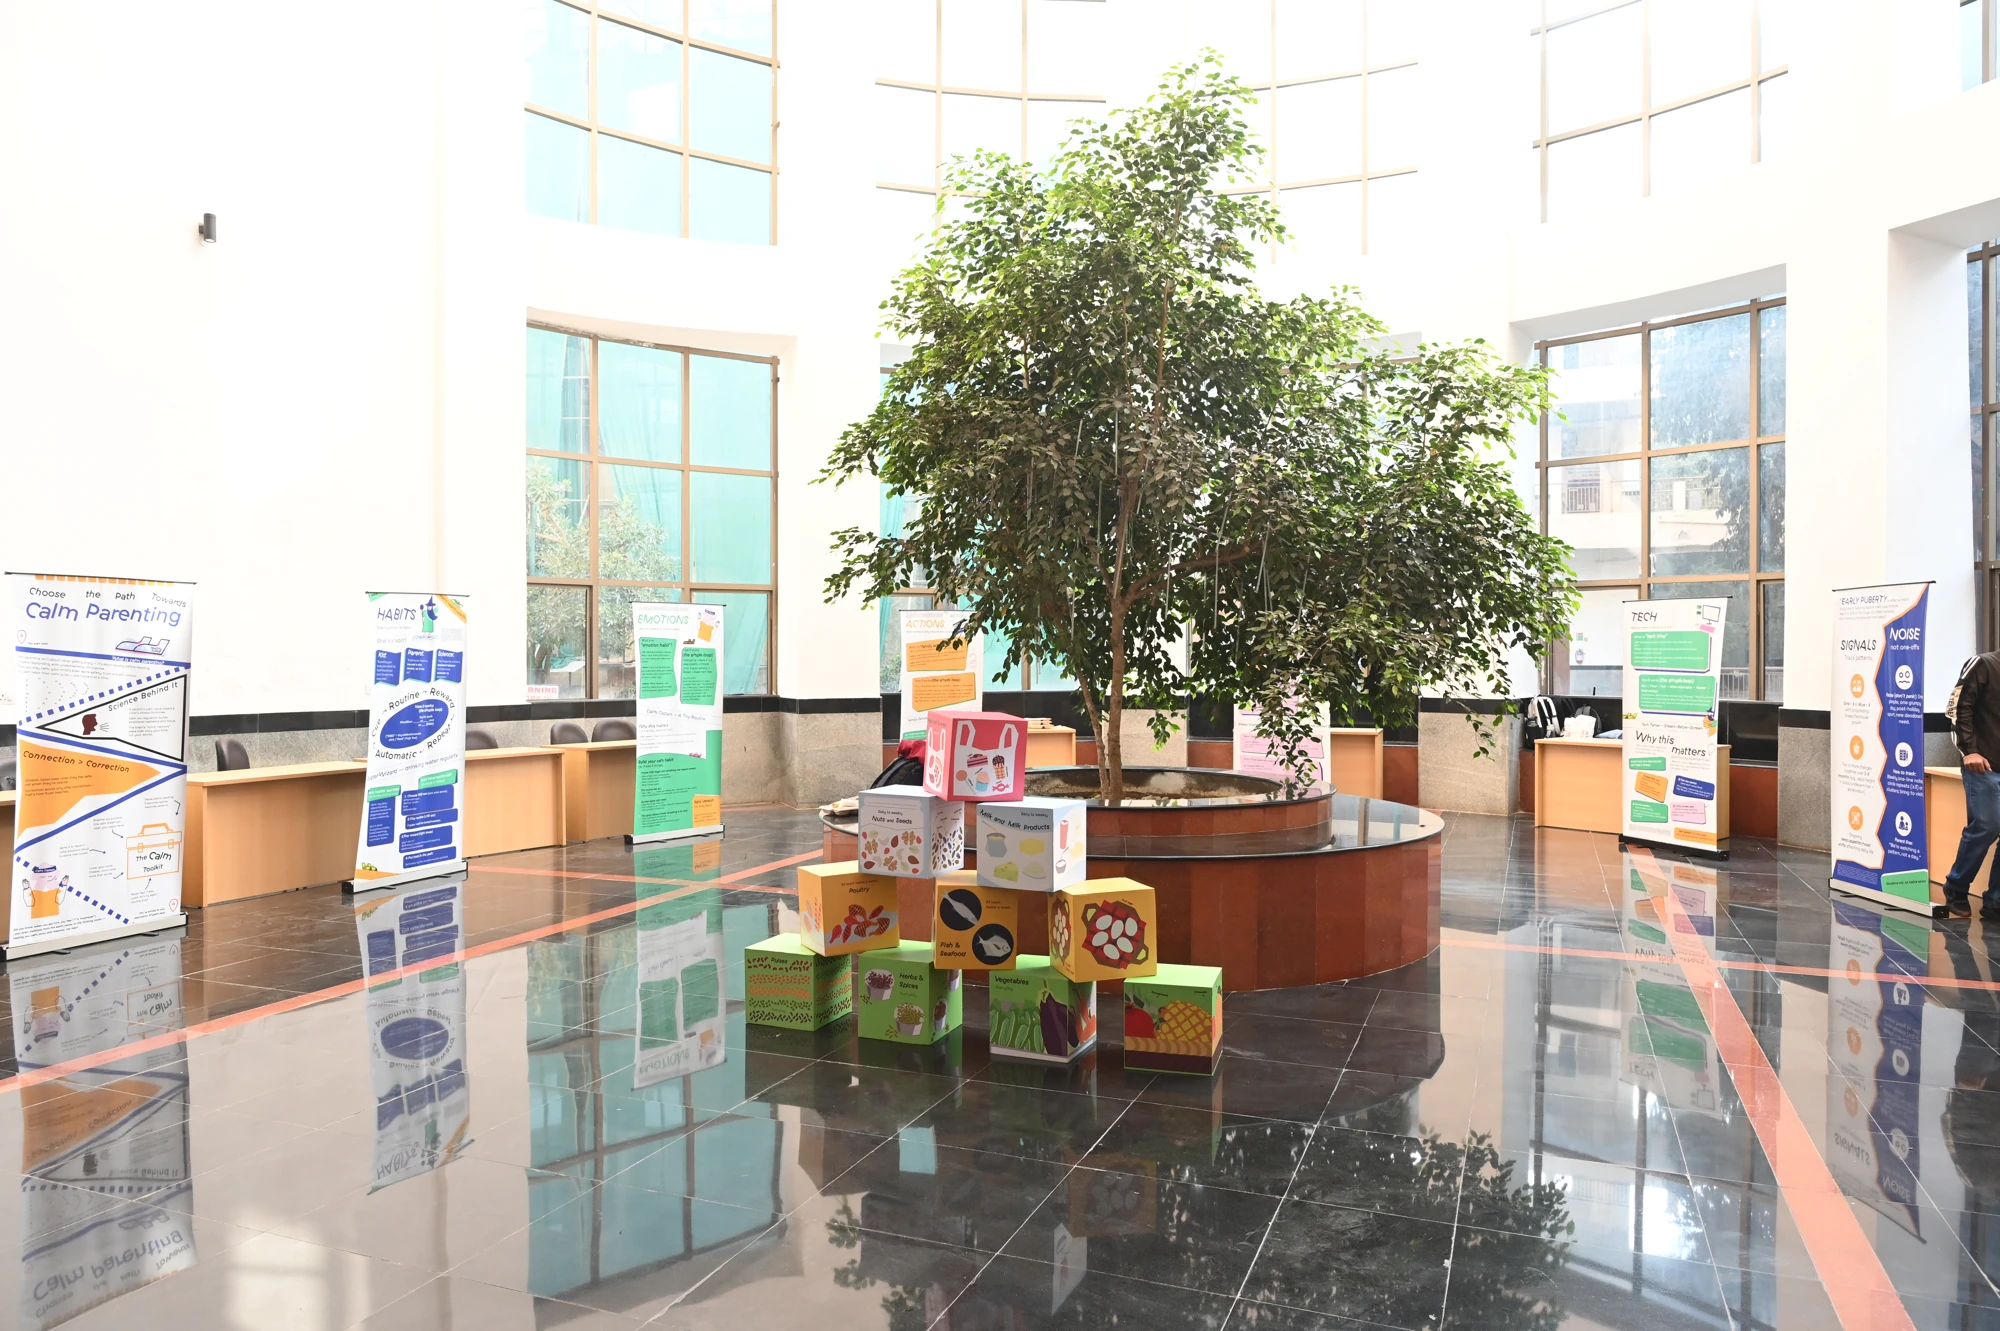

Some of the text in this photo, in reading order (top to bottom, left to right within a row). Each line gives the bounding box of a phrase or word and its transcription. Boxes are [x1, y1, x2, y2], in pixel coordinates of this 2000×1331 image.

[29, 587, 187, 608] Choose the Path Towards
[1860, 595, 1888, 604] PUBERTY
[26, 602, 181, 627] Calm Parenting
[377, 608, 416, 621] HABITS
[638, 614, 689, 624] EMOTIONS
[1631, 612, 1658, 622] TECH
[906, 620, 945, 628] ACTIONS
[1890, 628, 1920, 641] NOISE
[1840, 639, 1876, 651] SIGNALS
[108, 697, 138, 712] Science
[141, 685, 169, 700] Behind
[388, 692, 420, 710] Routine
[430, 687, 456, 708] Reward
[372, 718, 380, 737] Cue
[427, 724, 451, 749] Repeat
[1636, 730, 1675, 745] Why this
[375, 750, 418, 760] Automatic
[440, 753, 458, 762] regularly
[1672, 747, 1706, 757] matters
[23, 750, 75, 765] Connection
[86, 760, 130, 773] Correction
[980, 809, 1050, 831] Milk and Milk Products
[1900, 845, 1916, 854] watching
[149, 852, 172, 862] Calm
[143, 864, 163, 873] Toolkit
[899, 982, 918, 990] Spices
[995, 976, 1029, 986] Vegetables
